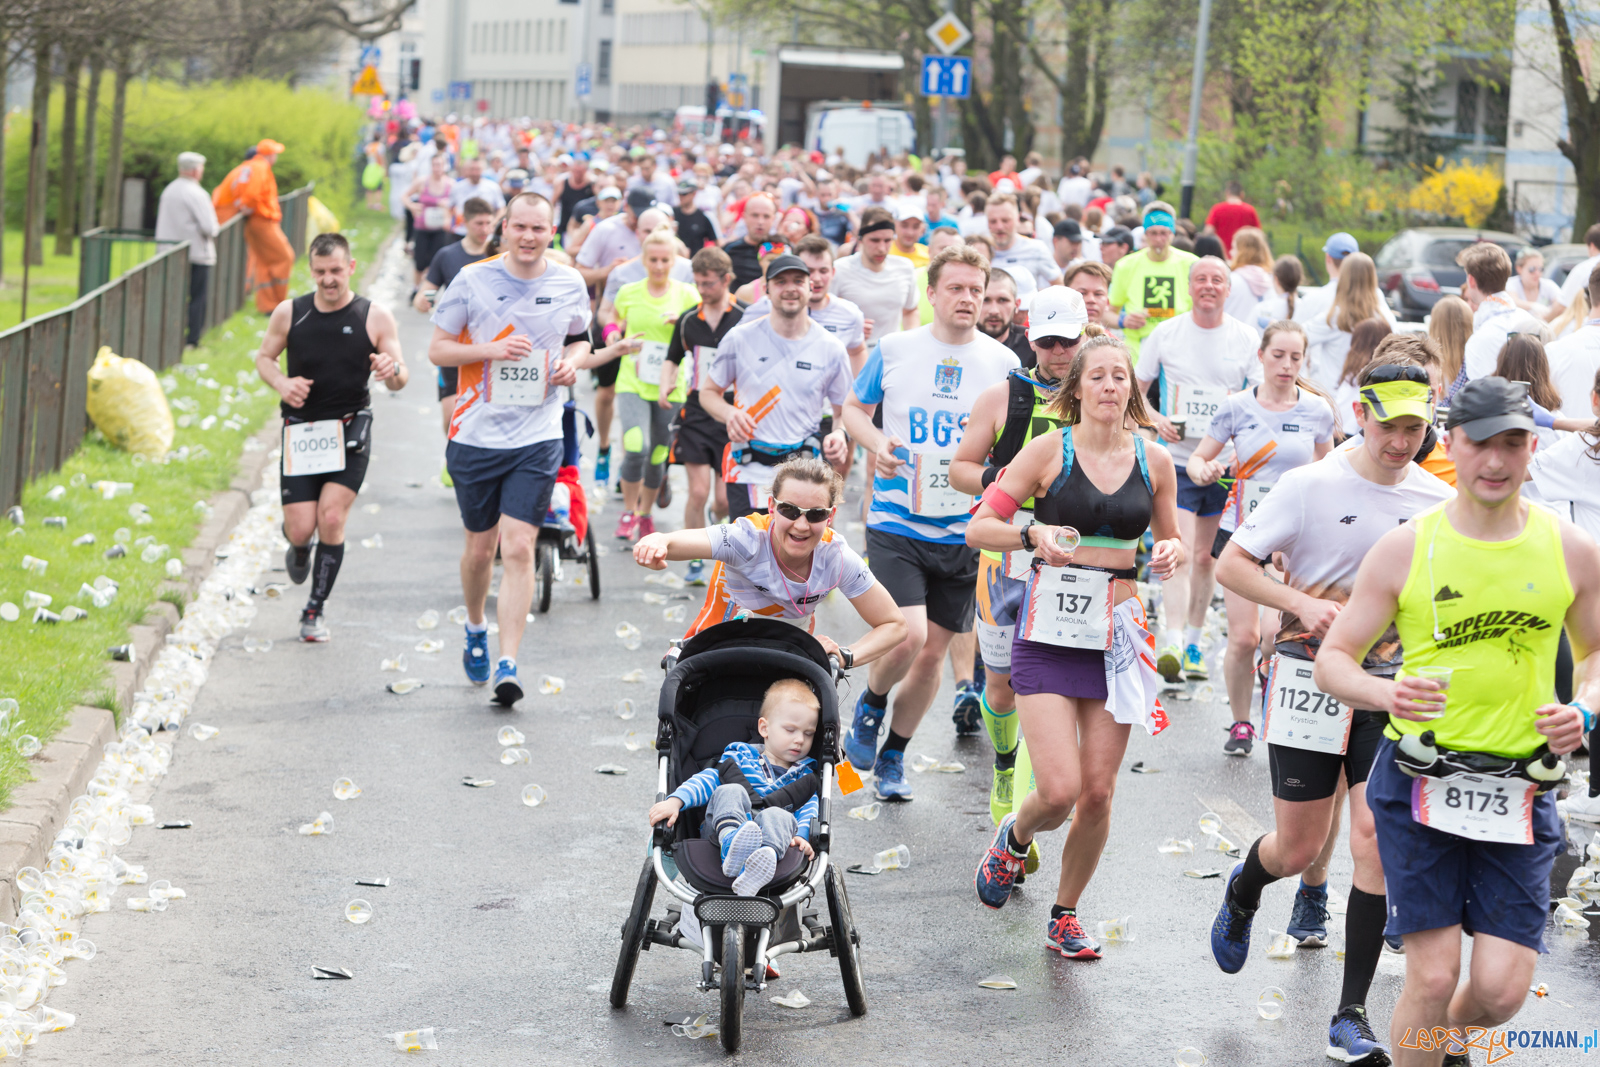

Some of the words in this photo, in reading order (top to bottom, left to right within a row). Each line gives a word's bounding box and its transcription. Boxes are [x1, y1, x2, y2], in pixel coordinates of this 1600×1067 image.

[646, 353, 662, 366] 86
[499, 366, 540, 382] 5328
[931, 392, 959, 401] POZNAŃ
[1185, 401, 1219, 416] 1328
[292, 436, 339, 454] 10005
[929, 473, 950, 489] 23
[1339, 515, 1358, 525] 4F
[1056, 592, 1093, 615] 137
[1055, 615, 1088, 626] KAROLINA
[1432, 610, 1551, 642] OZPĘDZENI
[1436, 627, 1510, 650] WIATREM
[1279, 686, 1340, 717] 11278
[1290, 715, 1318, 725] Krystian
[1445, 786, 1509, 816] 8173
